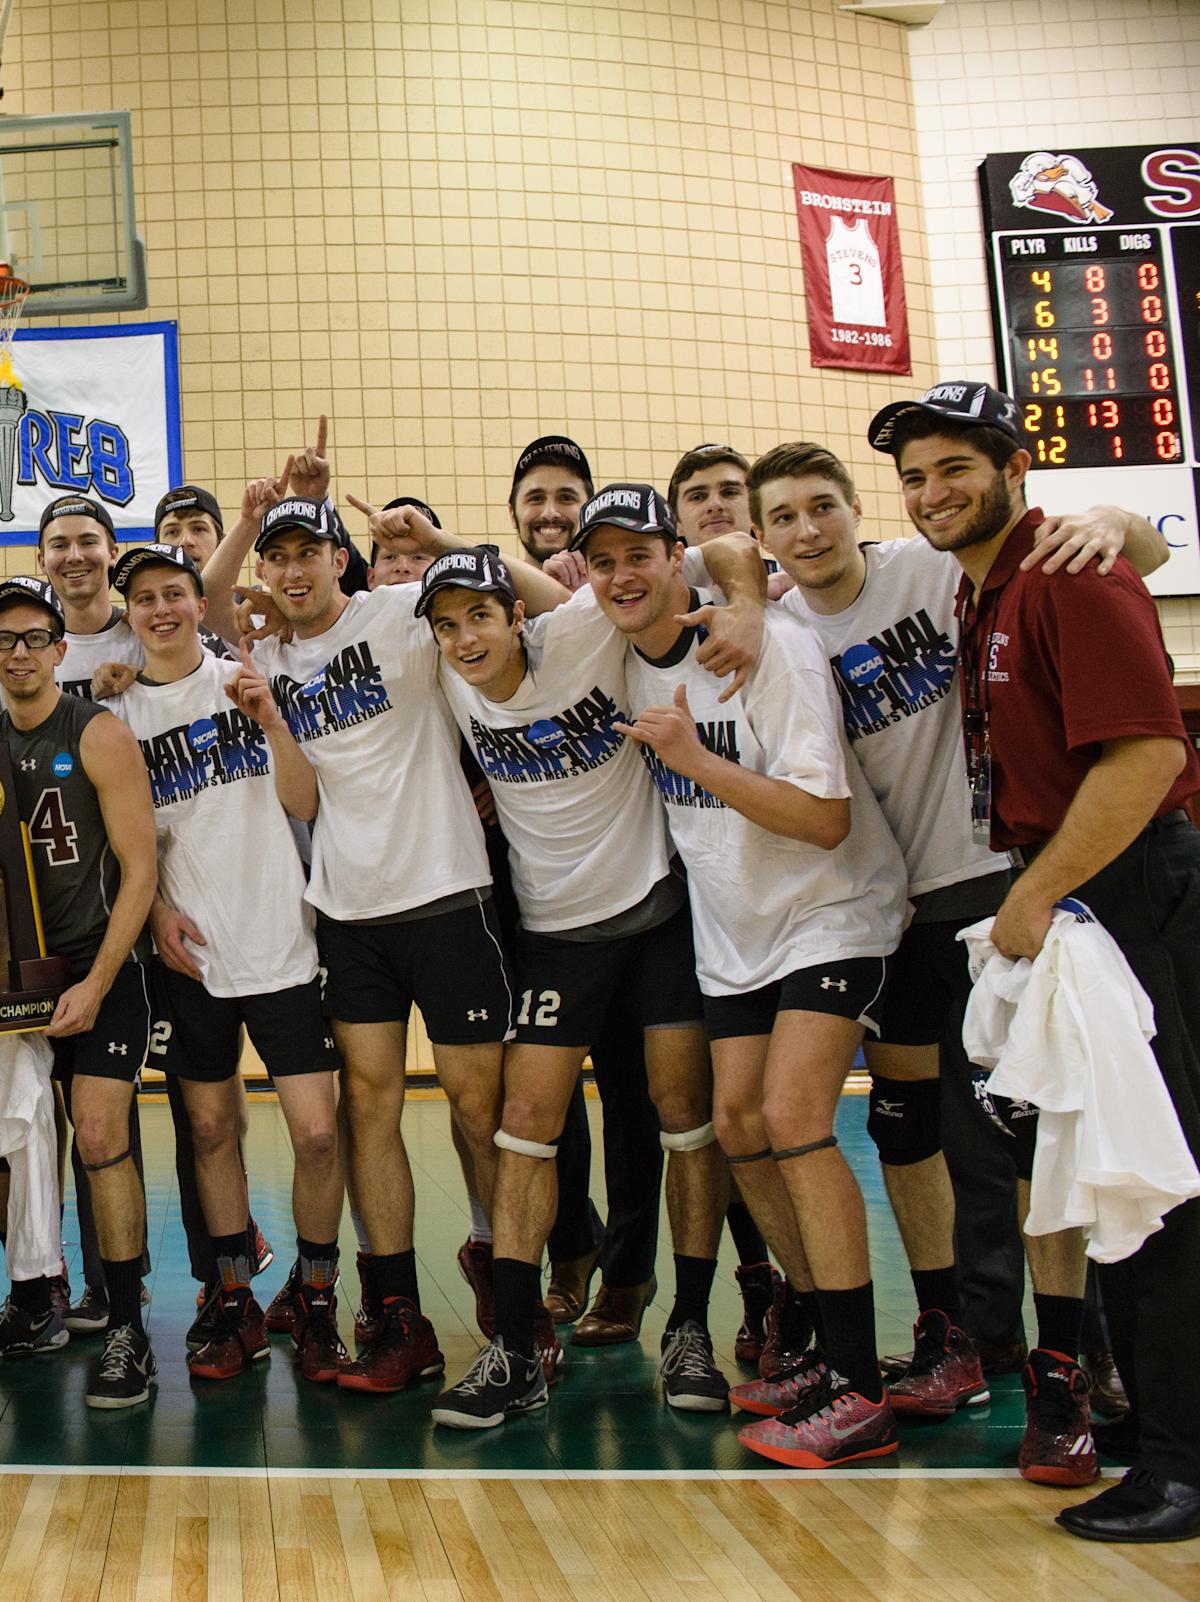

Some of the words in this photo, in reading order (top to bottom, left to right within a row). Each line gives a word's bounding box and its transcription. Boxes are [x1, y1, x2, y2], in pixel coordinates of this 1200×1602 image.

[800, 190, 892, 217] BRONSTEIN
[1011, 237, 1046, 255] PLYR
[1064, 235, 1098, 253] KILLS
[1119, 233, 1152, 251] DIGS
[848, 263, 863, 286] 3
[1031, 270, 1052, 293] 4
[1085, 266, 1105, 293] 8
[1138, 263, 1159, 290] 0
[1035, 300, 1055, 328] 6
[1092, 298, 1109, 326] 3
[1142, 295, 1162, 323] 0
[831, 328, 893, 348] 1982-1986
[1028, 337, 1058, 361] 14
[1093, 333, 1112, 360] 0
[1146, 331, 1166, 358] 0
[1030, 368, 1062, 396] 15
[1084, 368, 1115, 391] 11
[1149, 363, 1169, 390] 0
[1024, 404, 1065, 432] 21
[1088, 400, 1119, 429] 13
[1153, 398, 1173, 426] 0
[1037, 435, 1067, 464] 12
[1113, 435, 1122, 458] 1
[1156, 431, 1176, 459] 0
[266, 500, 317, 526] CHAMPIONS
[584, 490, 641, 522] CHAMPIONS
[425, 553, 477, 586] CHAMPIONS
[849, 655, 884, 680] NCAA
[331, 699, 394, 732] VOLLEYBALL
[861, 710, 902, 737] MEN'S
[535, 729, 565, 745] NCAA
[54, 763, 72, 772] NCAA
[545, 766, 579, 781] MEN'S
[181, 789, 192, 801] III
[193, 775, 218, 797] MEN'S
[220, 765, 270, 785] VOLLEYBALL
[27, 786, 79, 867] 4
[517, 989, 562, 1027] 12
